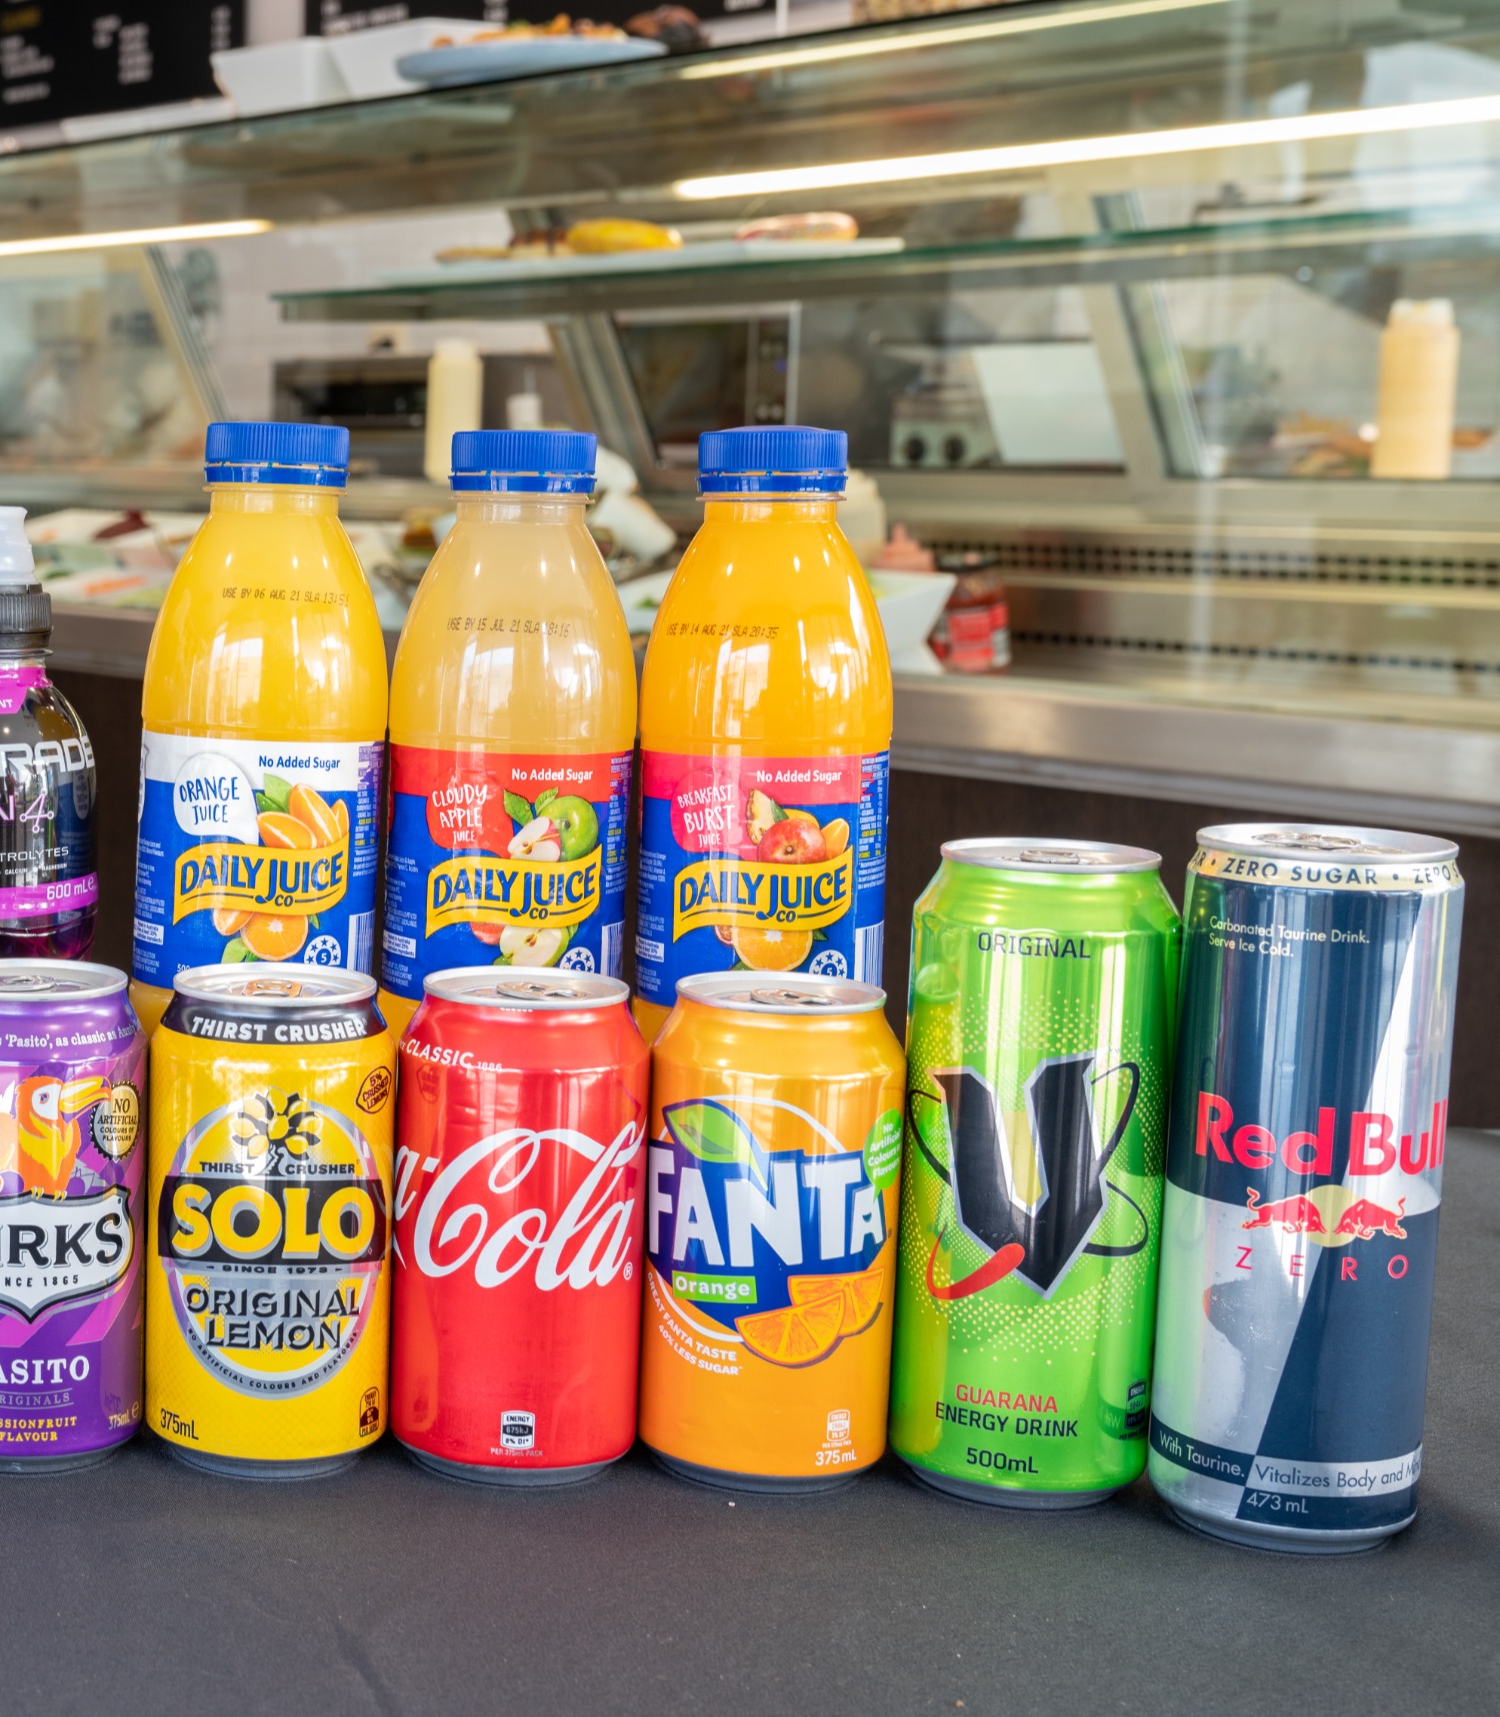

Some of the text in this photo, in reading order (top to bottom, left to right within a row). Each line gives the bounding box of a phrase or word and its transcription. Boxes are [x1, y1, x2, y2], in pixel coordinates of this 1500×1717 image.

[223, 588, 236, 599] USE
[241, 589, 251, 599] BY
[254, 589, 265, 599] 06
[270, 590, 286, 600] AUG
[290, 590, 300, 601] 21
[304, 592, 320, 603] SLA
[259, 755, 340, 771] No Added Sugar
[757, 770, 842, 785] No Added Sugar
[179, 776, 240, 803] ORANGE
[432, 784, 488, 807] CLOUDY
[678, 784, 733, 809] BREAKFAST
[193, 804, 229, 825] JUICE
[440, 807, 482, 829] APPLE
[683, 805, 735, 834] BURST
[180, 851, 344, 904] DAILY JUICE
[1223, 857, 1378, 885] ZERO SUGAR
[46, 882, 71, 900] 600
[275, 894, 294, 907] CO
[433, 862, 597, 916] DAILY JUICE
[680, 864, 847, 921] DAILY JUICE
[1209, 915, 1370, 945] Carbonated Taurine Drink.
[977, 931, 1092, 960] ORIGINAL
[56, 1036, 69, 1047] as
[71, 1028, 106, 1046] classic
[190, 1017, 368, 1043] THIRST CRUSHER
[406, 1038, 503, 1071] CLASSIC 1886
[1195, 1090, 1448, 1176] Red Bull
[927, 1050, 1108, 1300] V
[649, 1146, 884, 1267] FANTA
[171, 1183, 377, 1260] SOLO
[222, 1265, 328, 1274] SINCE 1973
[1235, 1245, 1409, 1281] ZERO
[43, 1274, 79, 1286] 1865
[675, 1275, 750, 1300] Orange
[183, 1283, 360, 1318] ORIGINAL
[648, 1272, 737, 1361] GREAT FANTA TASTE
[204, 1317, 341, 1350] LEMON
[659, 1325, 674, 1346] 40%
[674, 1343, 697, 1365] LESS
[197, 1345, 243, 1384] ARTIFICIAL
[249, 1380, 296, 1390] COLOURS
[301, 1373, 319, 1386] AND
[323, 1332, 357, 1374] FLAVOURS
[955, 1383, 1059, 1414] GUARANA
[160, 1408, 199, 1441] 375mL
[935, 1402, 1079, 1438] ENERGY DRINK
[815, 1449, 857, 1466] 375 mL
[966, 1446, 1039, 1474] 500mL
[1159, 1429, 1403, 1490] With Taurine. Vitalizes Body and
[1246, 1492, 1309, 1514] 473 mL
